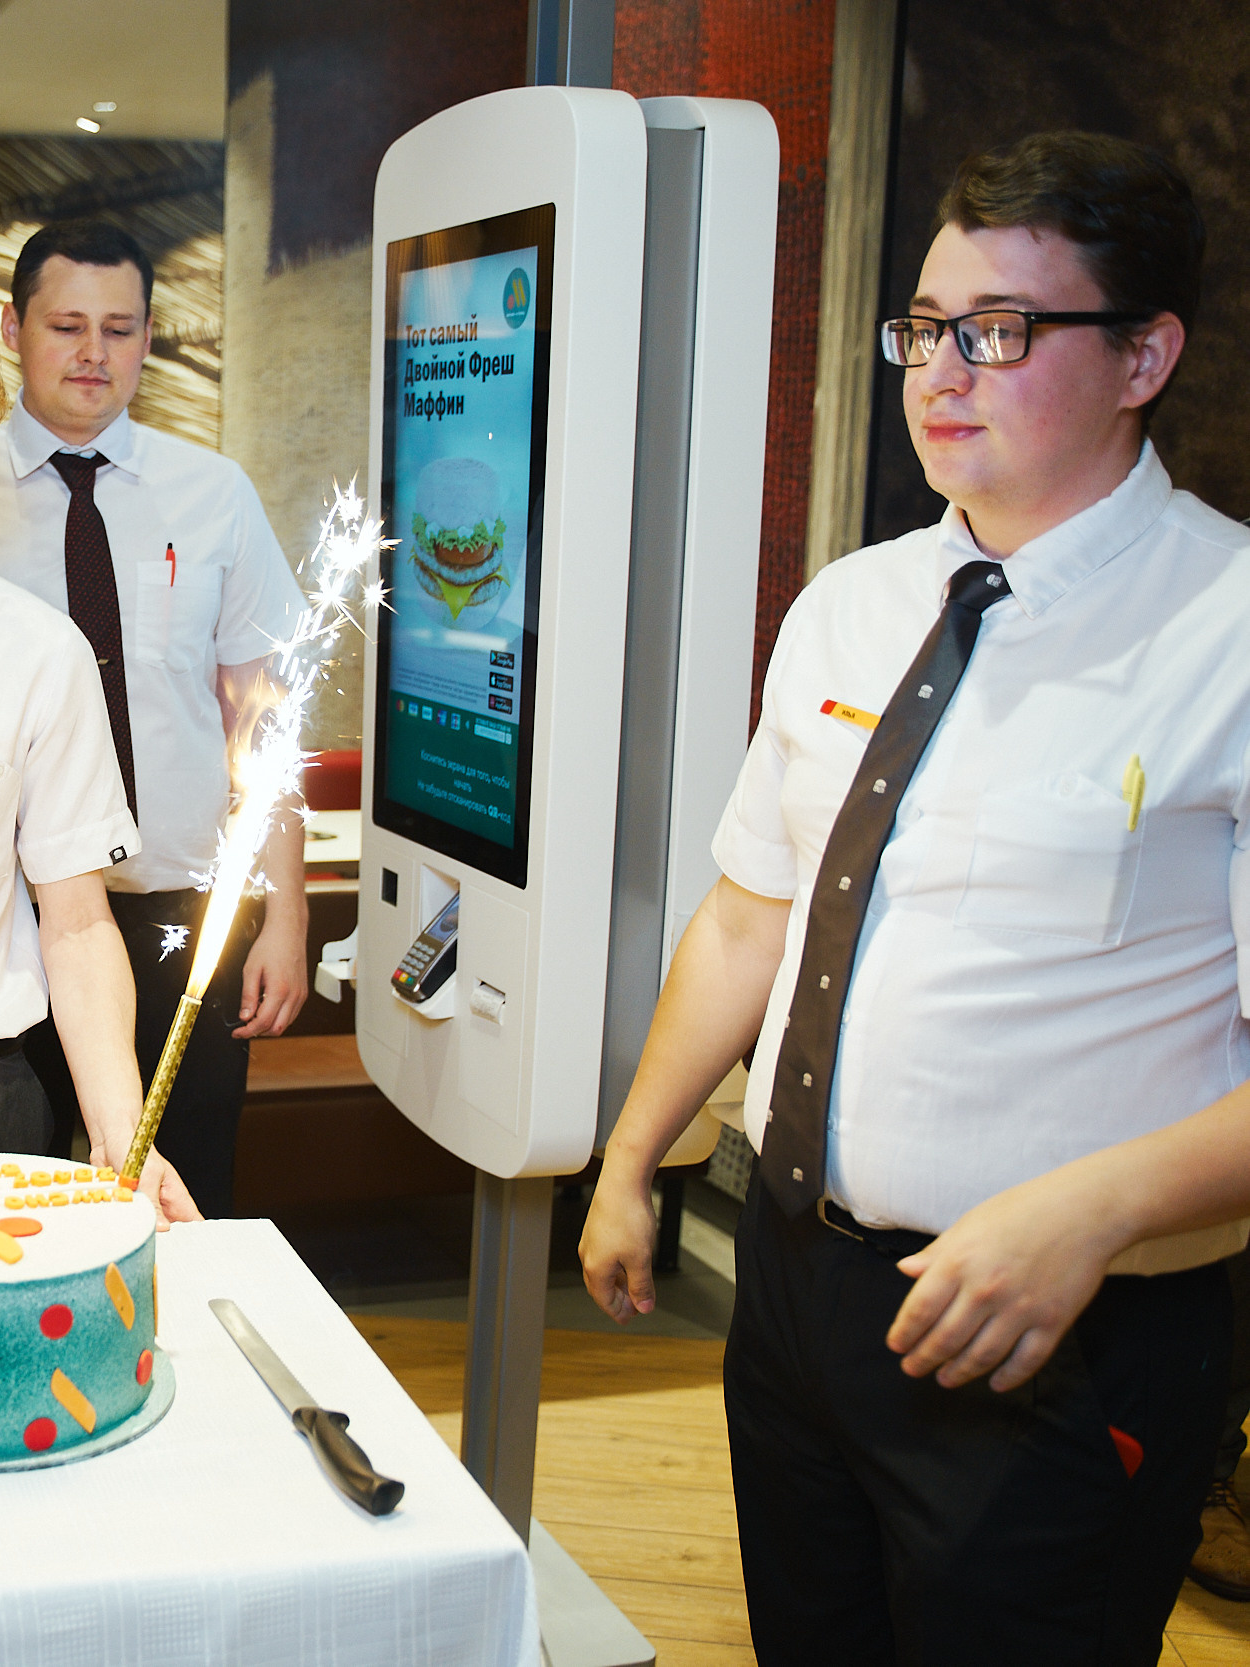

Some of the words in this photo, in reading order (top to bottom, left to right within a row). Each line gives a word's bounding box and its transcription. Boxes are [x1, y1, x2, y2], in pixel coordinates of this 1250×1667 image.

[406, 326, 426, 348] Тот
[429, 315, 478, 345] самый
[404, 352, 465, 388] Двойной
[469, 350, 514, 382] Фреш
[404, 390, 464, 421] Маффин
[420, 749, 446, 767] Коснитесь
[447, 760, 465, 774] экрана
[466, 766, 476, 777] для
[476, 770, 490, 784] того,
[491, 775, 510, 789] чтобы
[453, 779, 472, 793] начать
[448, 793, 487, 814] отсканировать
[488, 805, 511, 824] QR-код
